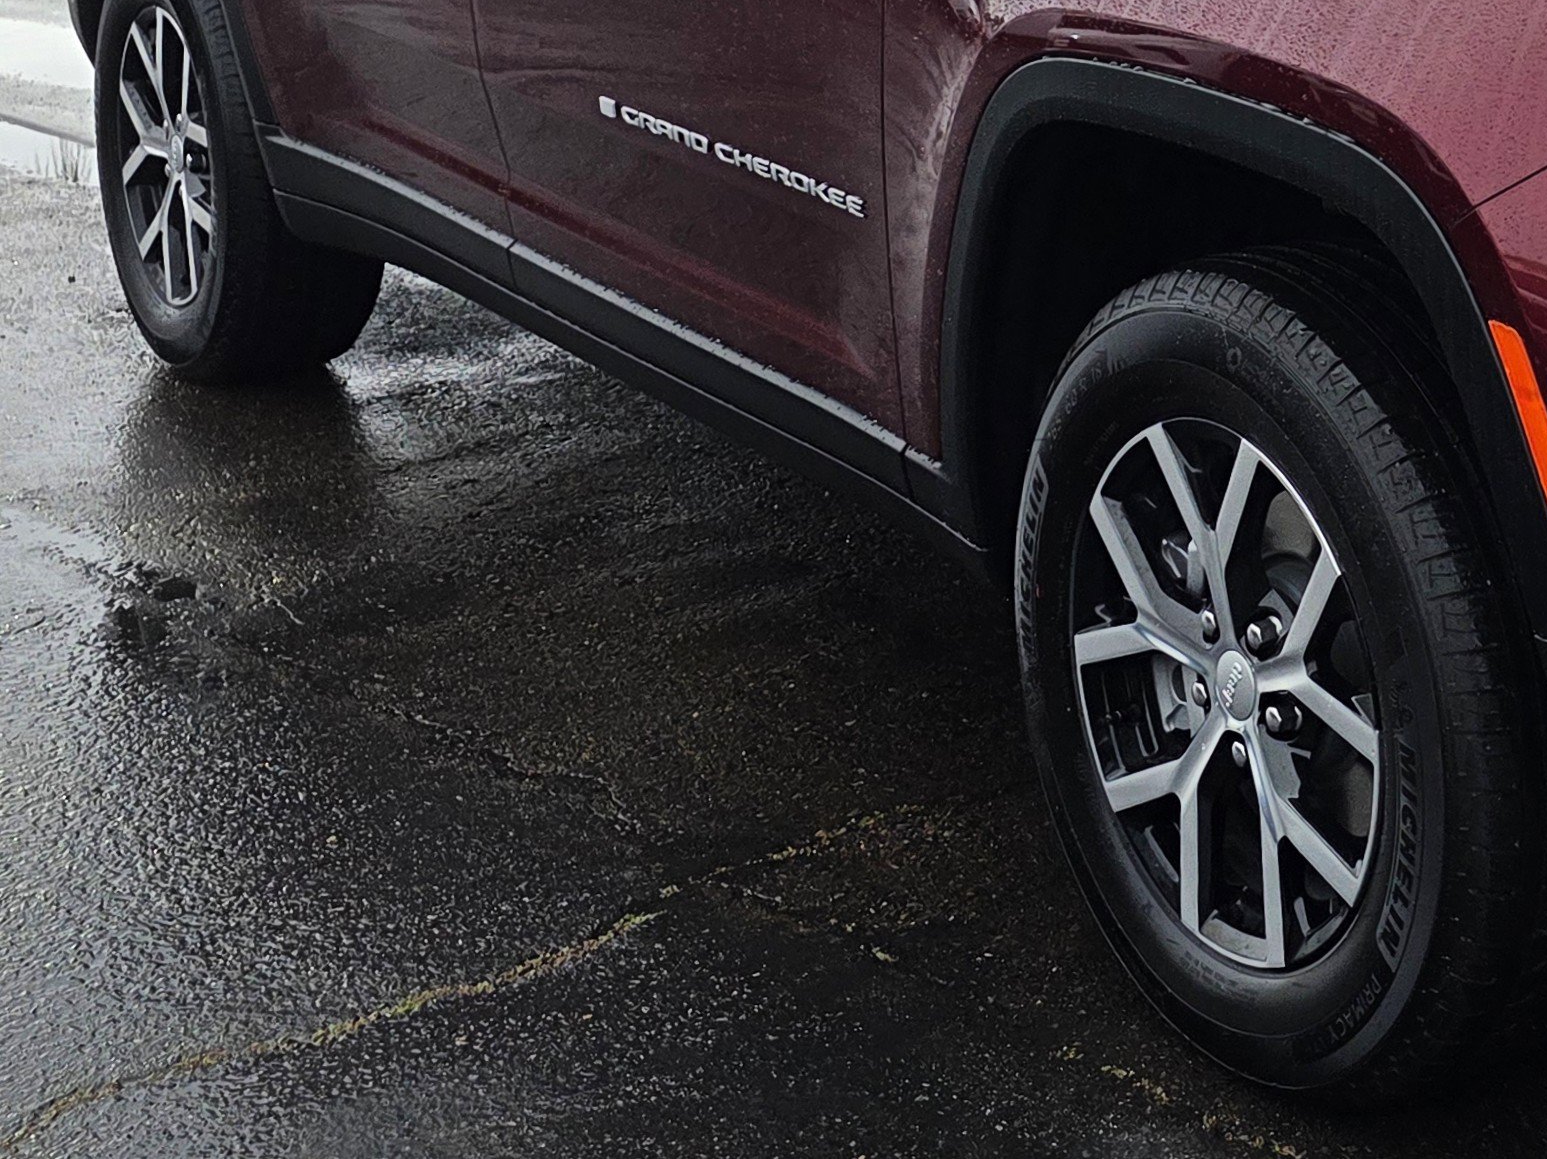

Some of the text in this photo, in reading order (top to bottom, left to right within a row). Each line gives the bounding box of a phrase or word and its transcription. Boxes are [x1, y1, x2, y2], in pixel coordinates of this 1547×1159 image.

[620, 105, 865, 218] GRAND CHEROKEE
[1019, 468, 1045, 652] MICHELIN
[1381, 741, 1418, 958] MICHELIN
